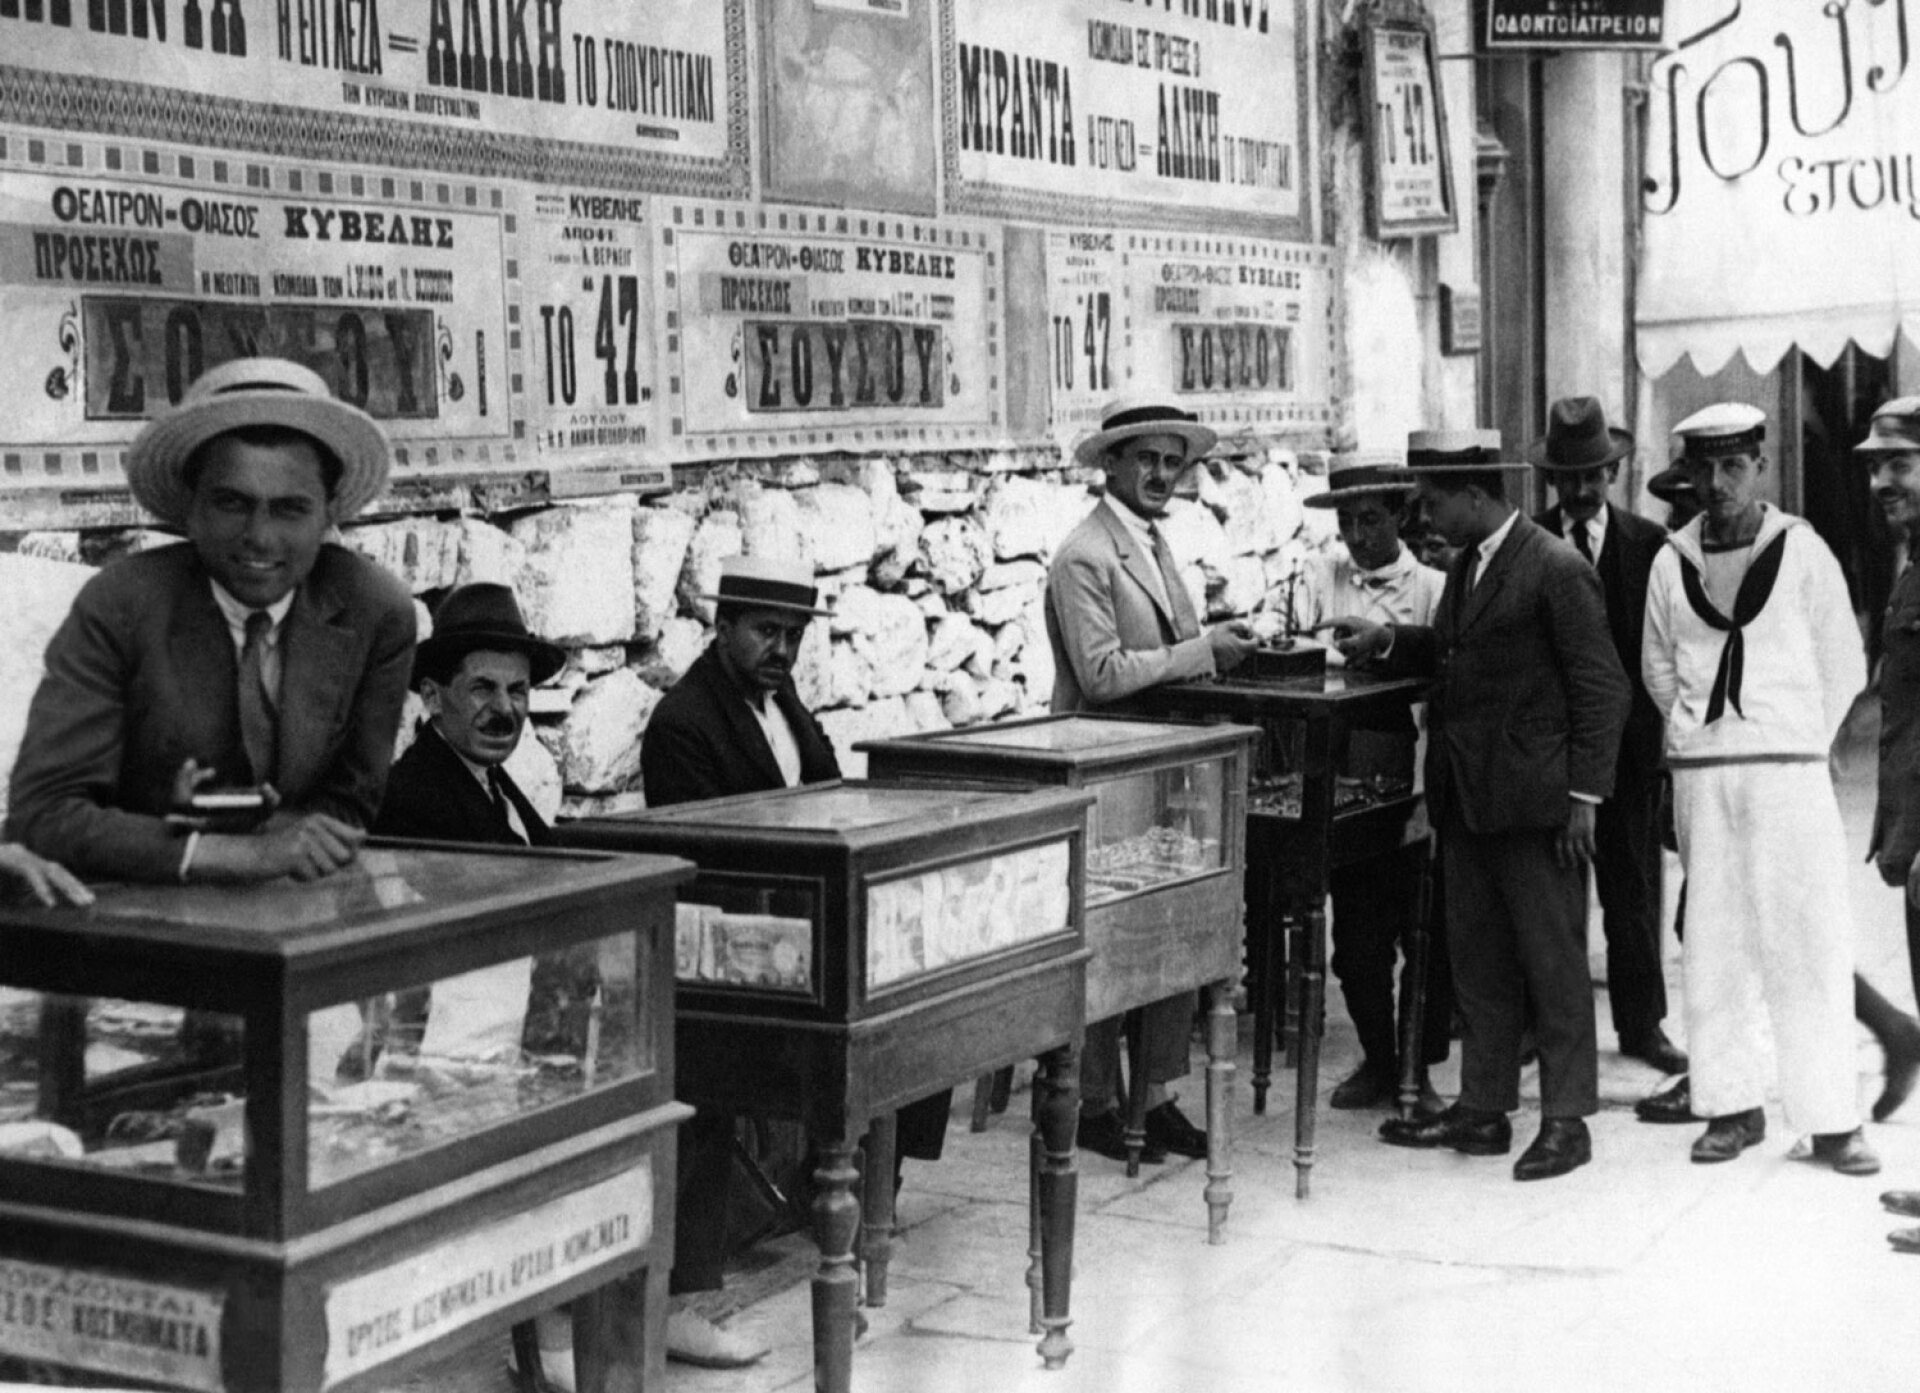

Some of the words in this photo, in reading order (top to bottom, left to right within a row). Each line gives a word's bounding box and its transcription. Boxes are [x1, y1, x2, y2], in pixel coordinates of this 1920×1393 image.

[573, 33, 597, 107] ΤΟ
[604, 38, 714, 123] ΣΠΟΥΡΓΙΤΑΚΙ
[959, 43, 1076, 167] ΜΙΡΑΝΤΑ
[1157, 82, 1221, 183] ΑΛΙΚΗ
[283, 206, 454, 249] ΚΥΒΕΛΗΣ
[570, 192, 643, 223] ΚΥΒΕΛΗΣ
[33, 232, 162, 285] ΠΡΟΣΕΧΩΣ
[856, 247, 955, 279] ΚΥΒΕΛΗΣ
[721, 277, 791, 314] ΠΡΟΣΕΧΩΣ
[540, 305, 578, 405] ΤΟ
[757, 325, 936, 407] ΣΟΥΣΟΥ
[1179, 327, 1290, 390] ΣΟΥΣΟΥ
